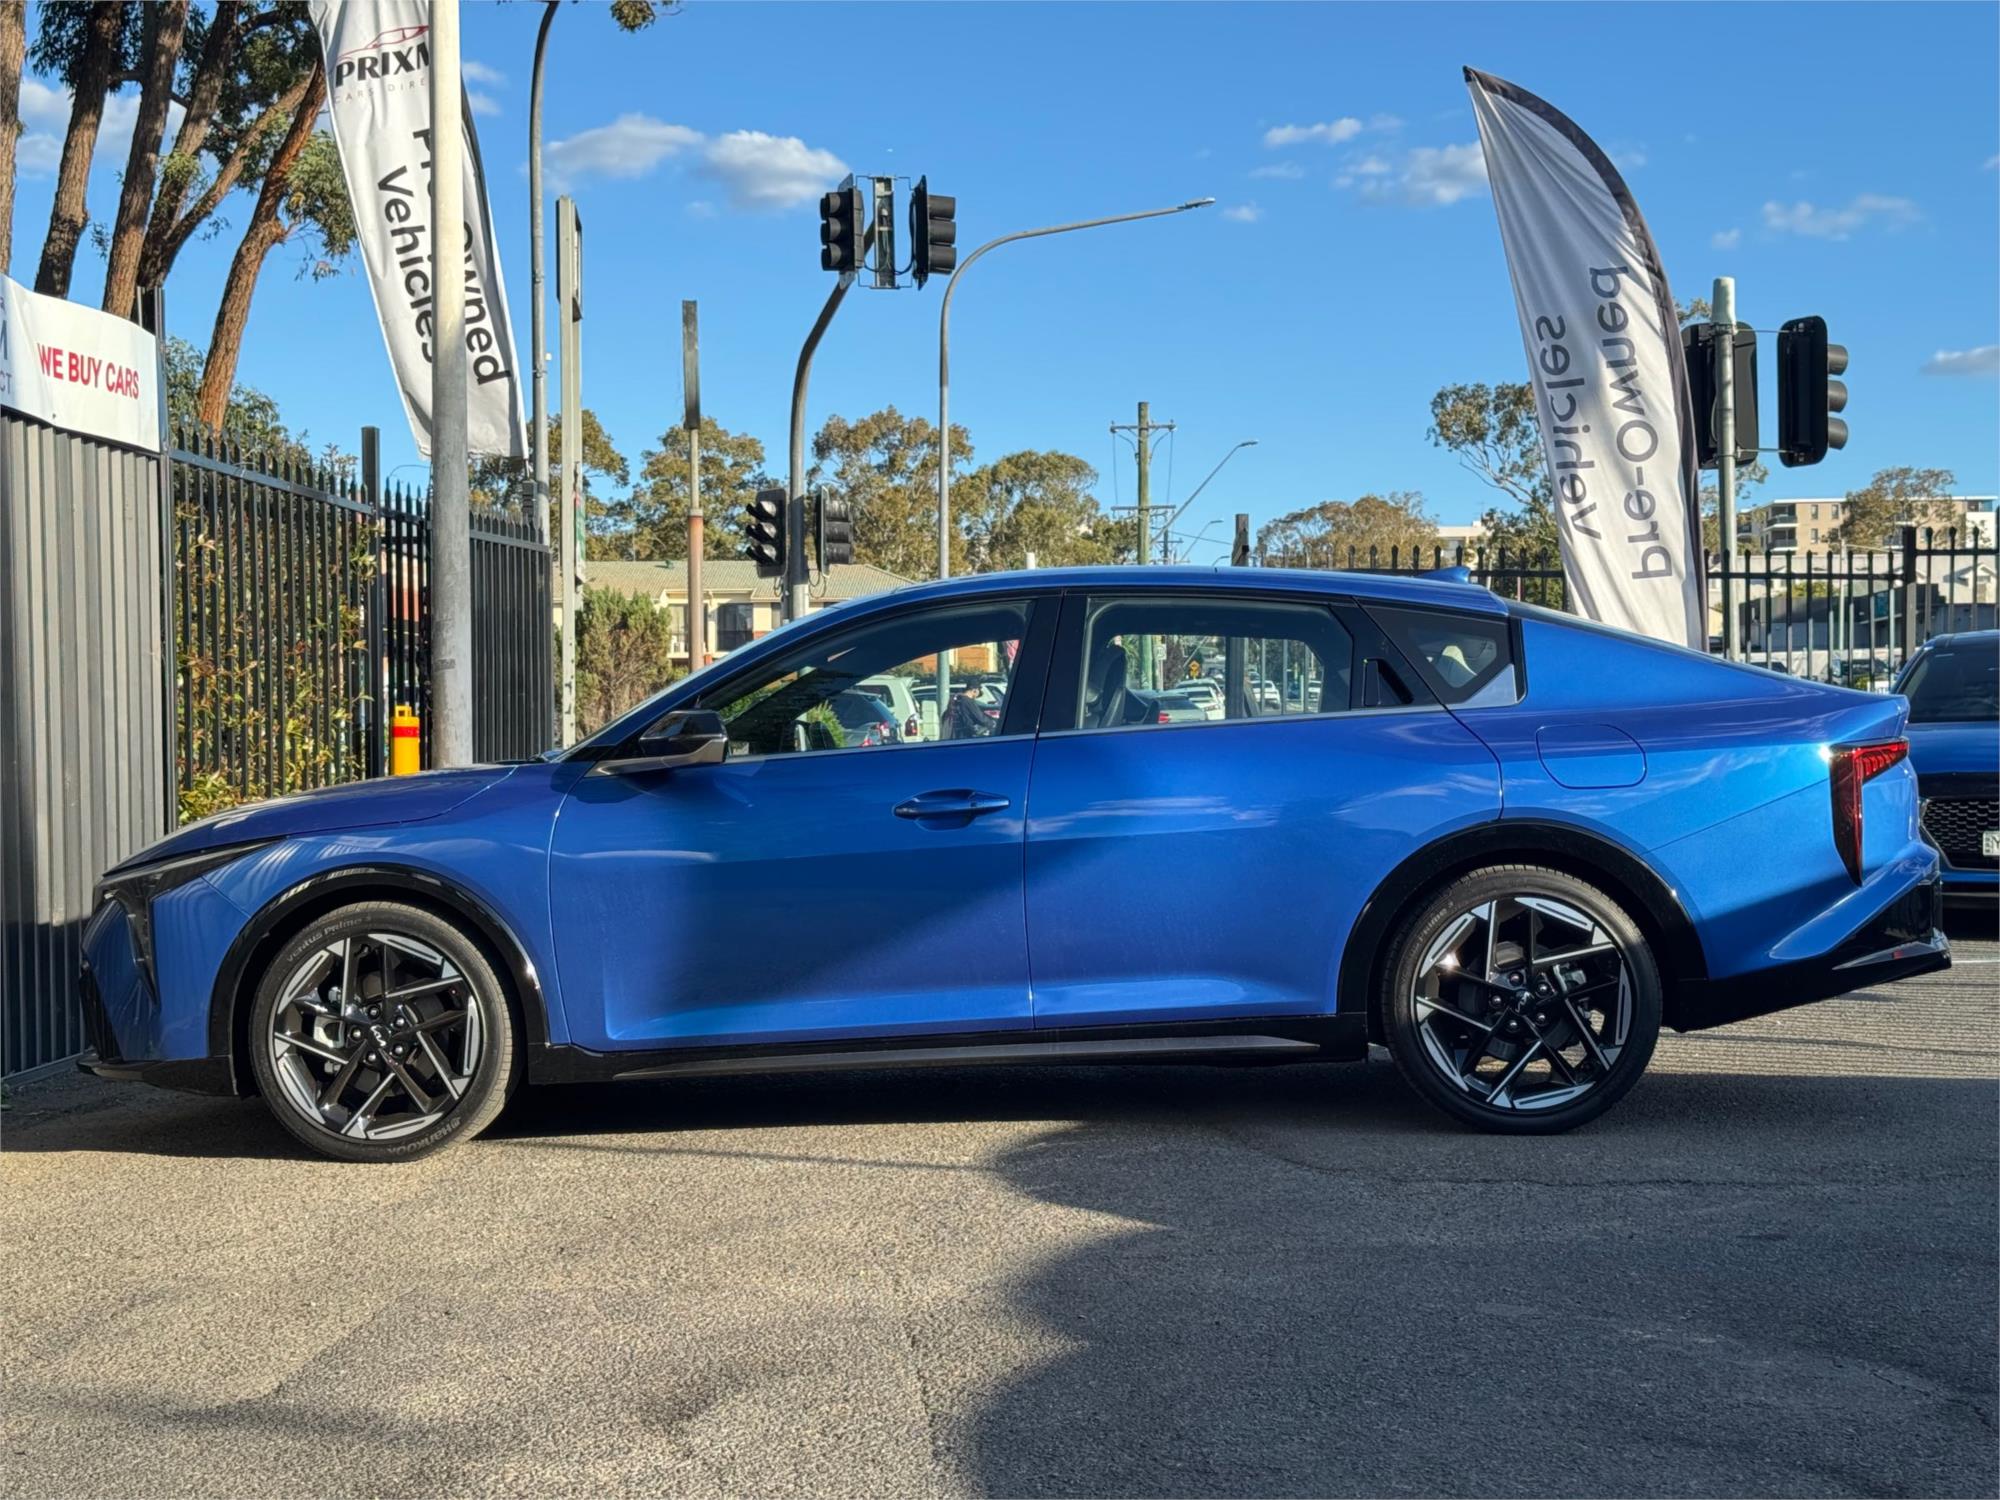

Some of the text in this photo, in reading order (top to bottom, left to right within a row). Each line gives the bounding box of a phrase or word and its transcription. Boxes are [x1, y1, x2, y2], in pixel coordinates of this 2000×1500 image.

[37, 342, 140, 400] WE BUY CARS
